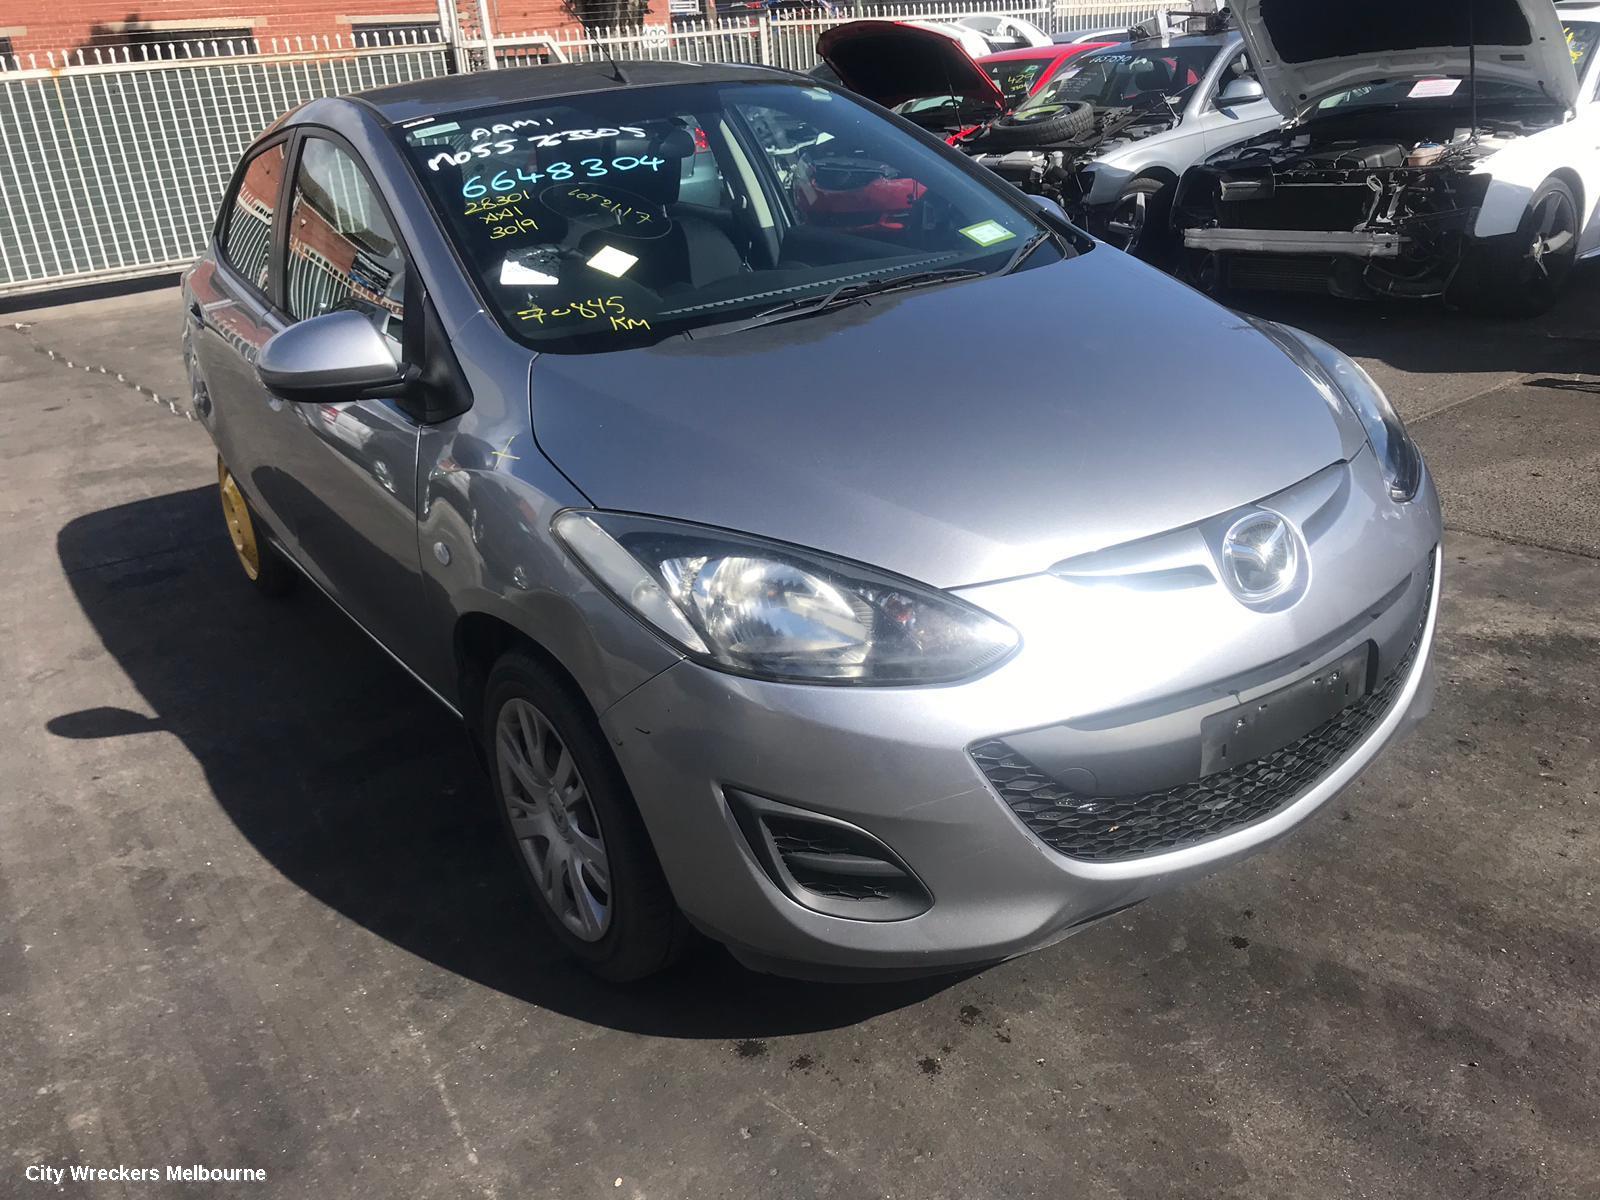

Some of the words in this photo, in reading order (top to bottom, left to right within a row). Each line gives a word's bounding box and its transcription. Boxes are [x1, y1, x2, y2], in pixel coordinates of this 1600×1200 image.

[462, 155, 666, 199] 6648304
[464, 190, 530, 215] 28301
[610, 316, 651, 331] KM
